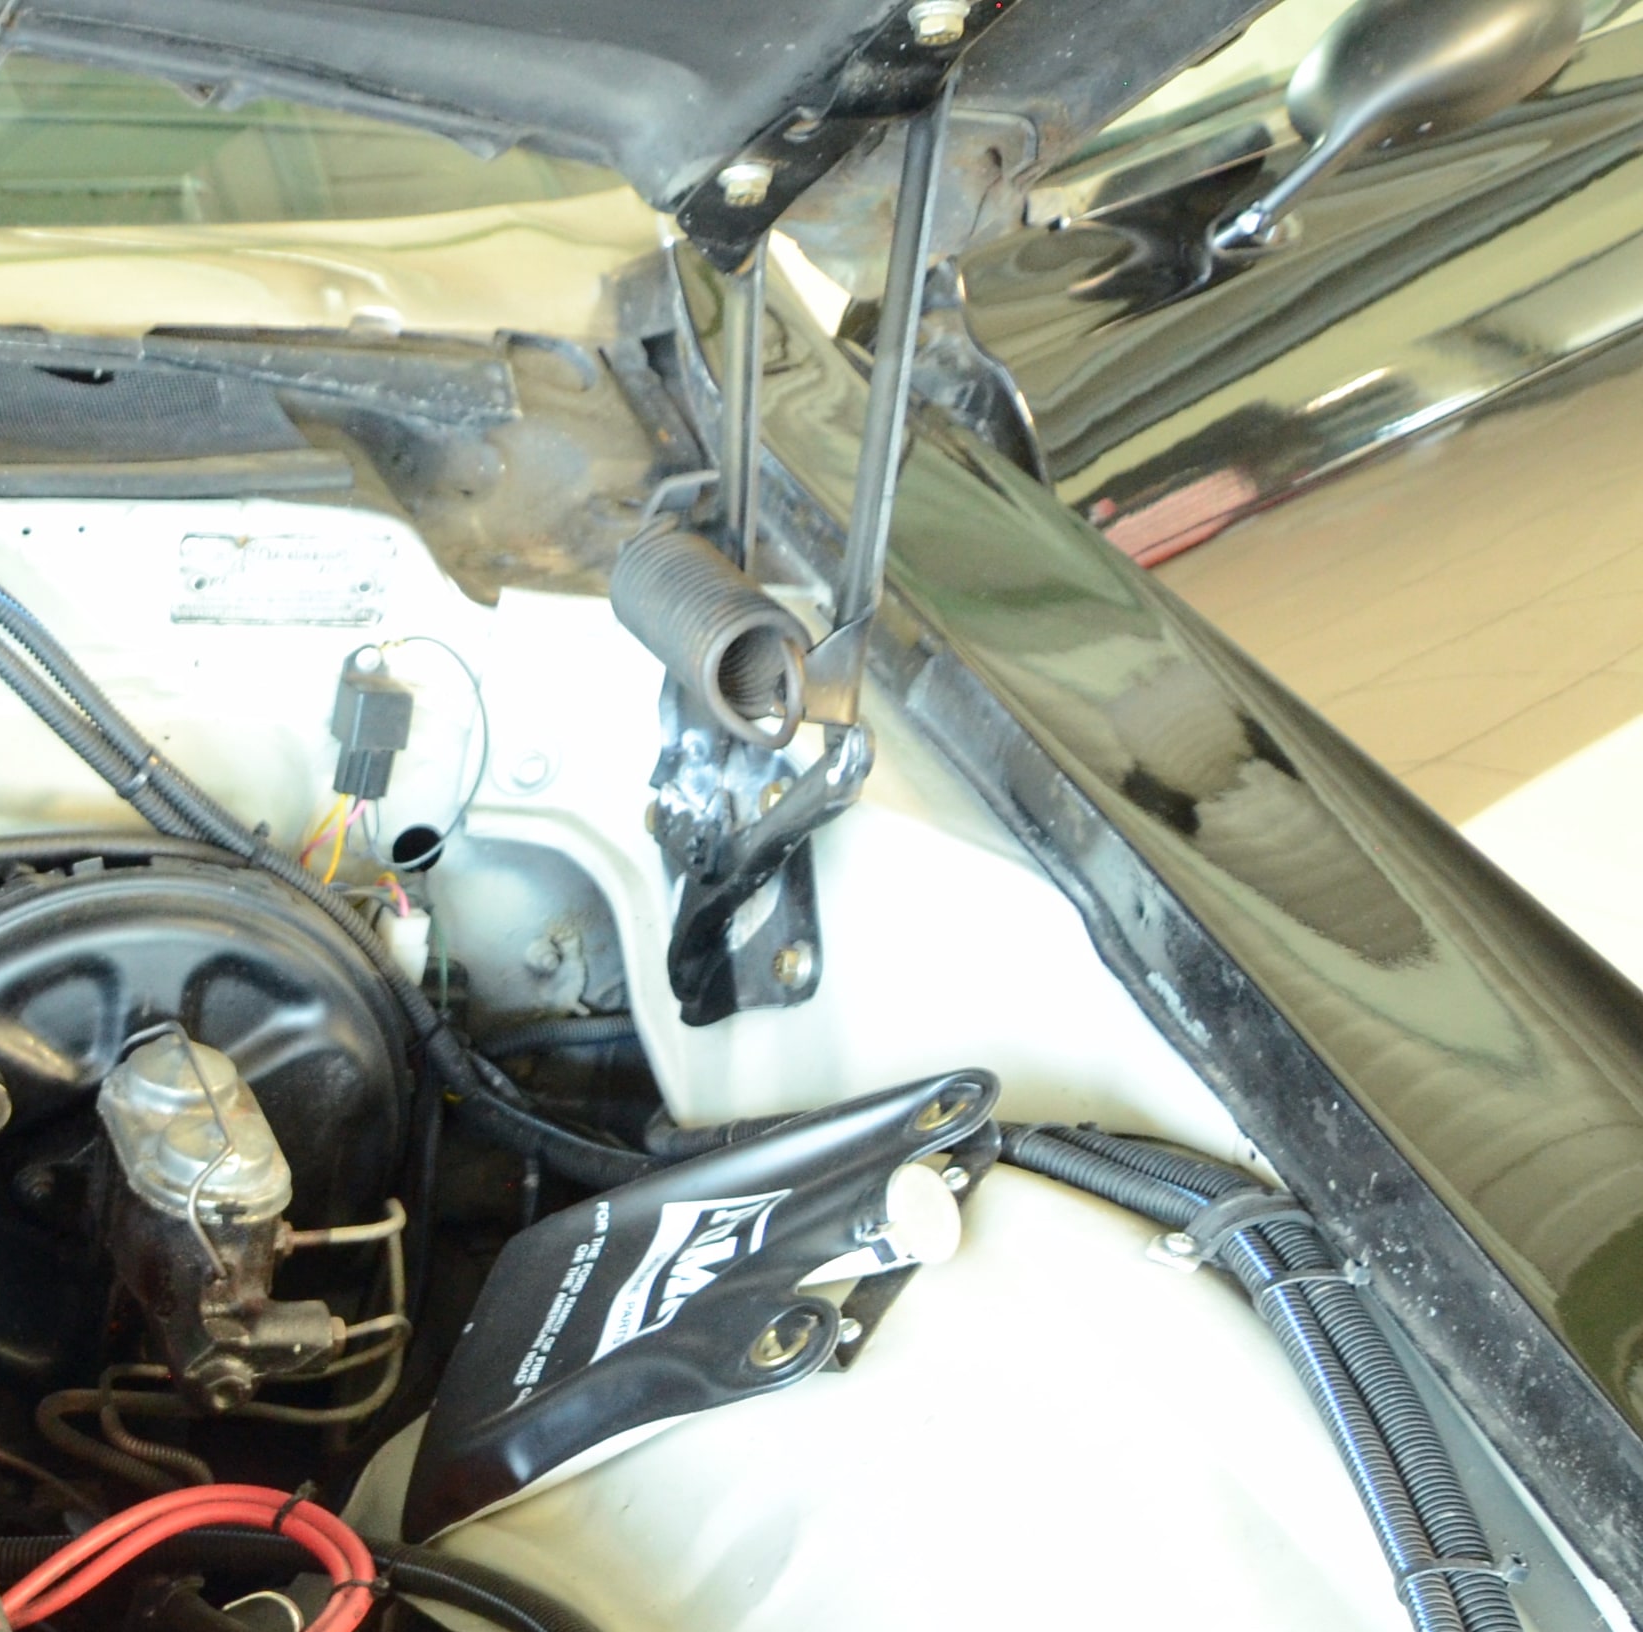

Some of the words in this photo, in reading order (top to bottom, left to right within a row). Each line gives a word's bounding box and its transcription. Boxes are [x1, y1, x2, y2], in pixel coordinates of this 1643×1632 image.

[595, 1201, 610, 1233] FOR
[571, 1243, 590, 1264] ON
[586, 1235, 606, 1260] THE
[561, 1266, 581, 1290] THE
[569, 1262, 594, 1295] FORD
[513, 1350, 538, 1386] ROAD
[526, 1355, 547, 1385] FINE
